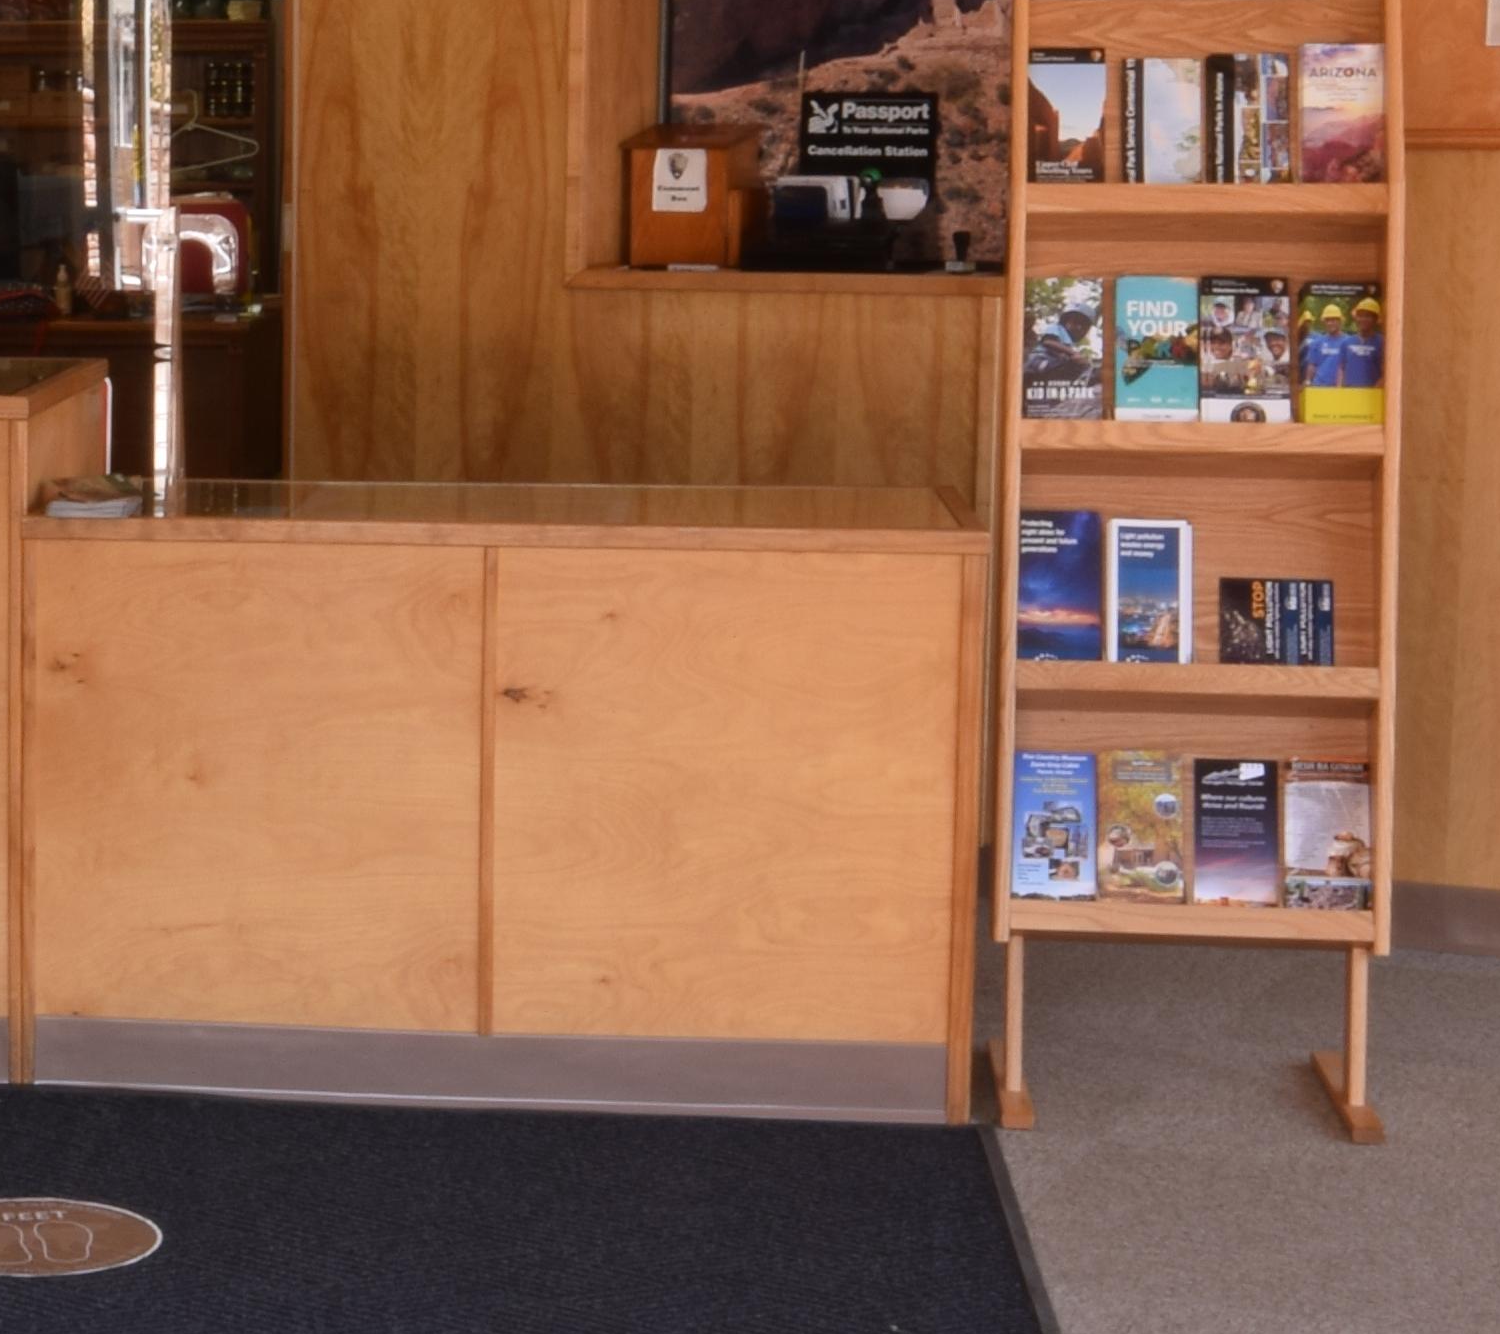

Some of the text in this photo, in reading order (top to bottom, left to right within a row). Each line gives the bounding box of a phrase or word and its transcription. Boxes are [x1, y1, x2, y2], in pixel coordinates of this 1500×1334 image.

[1308, 66, 1378, 79] ARIZONA
[1215, 71, 1224, 101] Arizona
[841, 100, 930, 124] Passport
[1125, 69, 1136, 167] Park Service Centennial
[1215, 111, 1224, 131] Parks
[871, 125, 904, 134] National
[905, 126, 930, 134] Parks
[807, 145, 929, 158] Cancellation Station
[1215, 132, 1224, 165] National
[1126, 300, 1178, 318] FIND
[1127, 319, 1190, 338] YOUR
[1026, 386, 1045, 401] KID
[1067, 386, 1096, 400] PARK
[1020, 519, 1054, 528] Protecting
[1251, 580, 1265, 619] STOP
[1, 1210, 67, 1223] FEET
